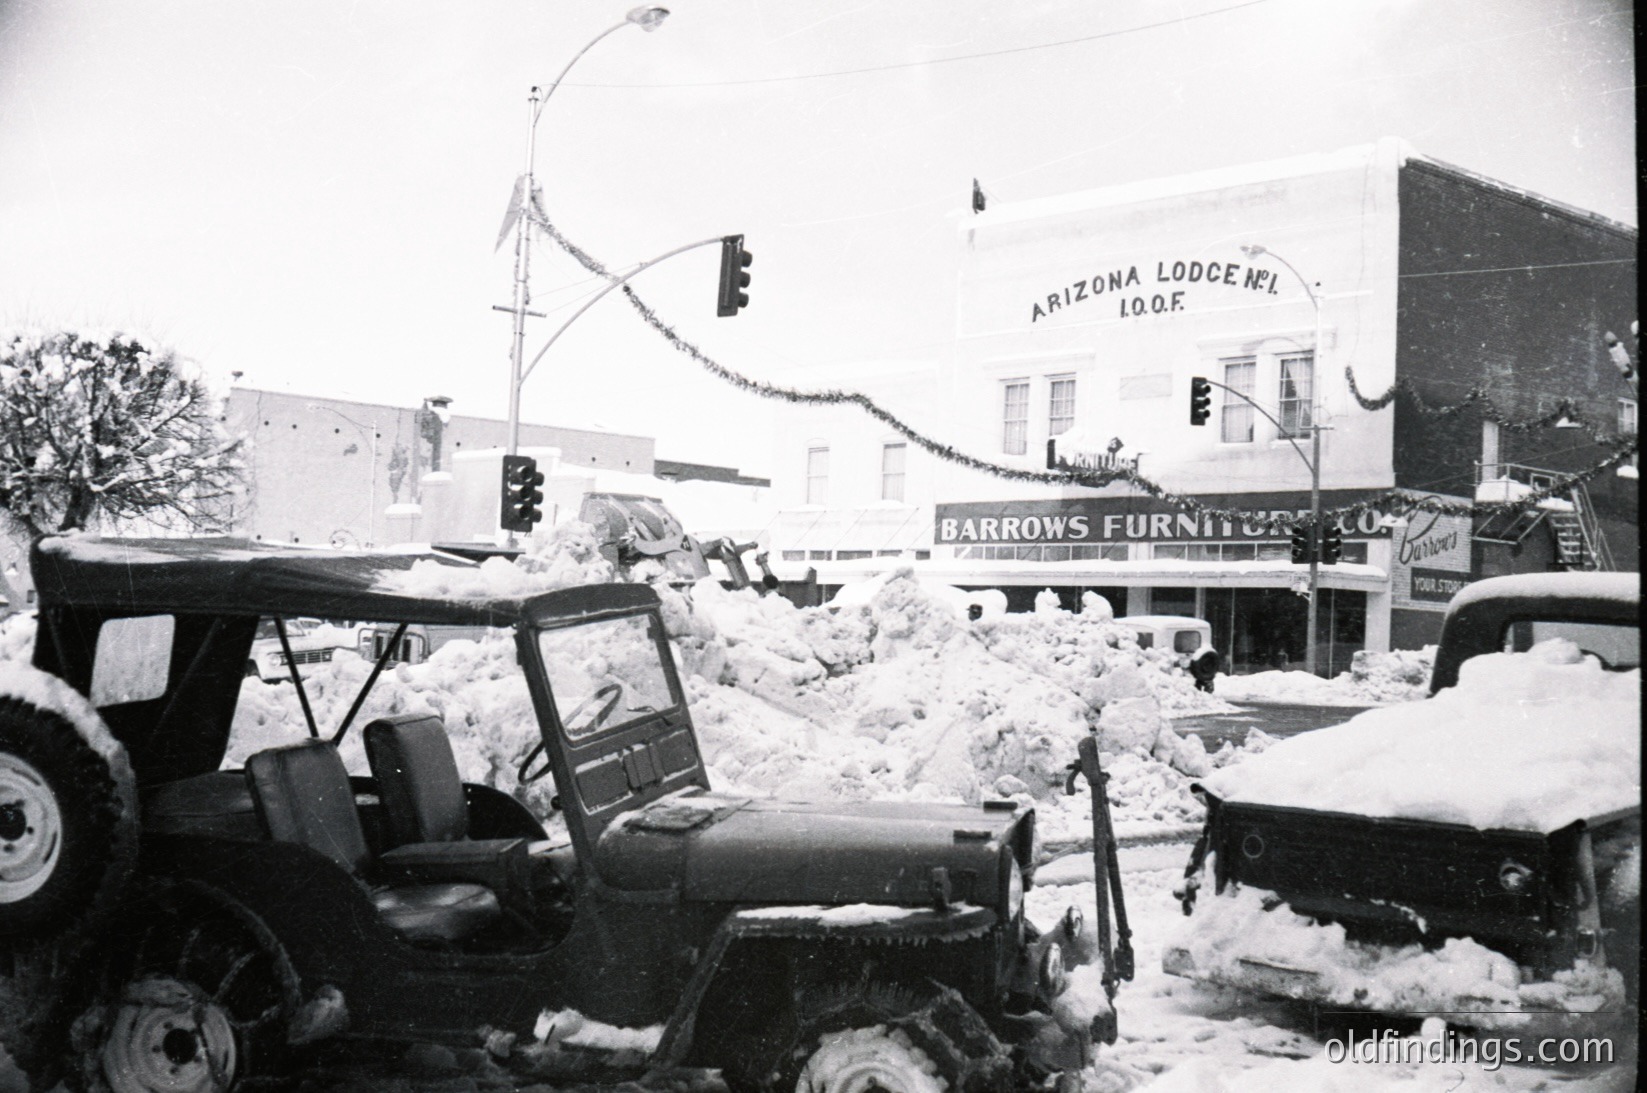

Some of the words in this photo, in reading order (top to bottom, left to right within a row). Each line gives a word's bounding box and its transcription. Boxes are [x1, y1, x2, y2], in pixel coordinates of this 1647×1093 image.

[1031, 265, 1141, 323] ARIZONA
[940, 516, 1090, 541] BARROWS
[1336, 508, 1387, 535] CO.
[1413, 576, 1437, 593] YOUR
